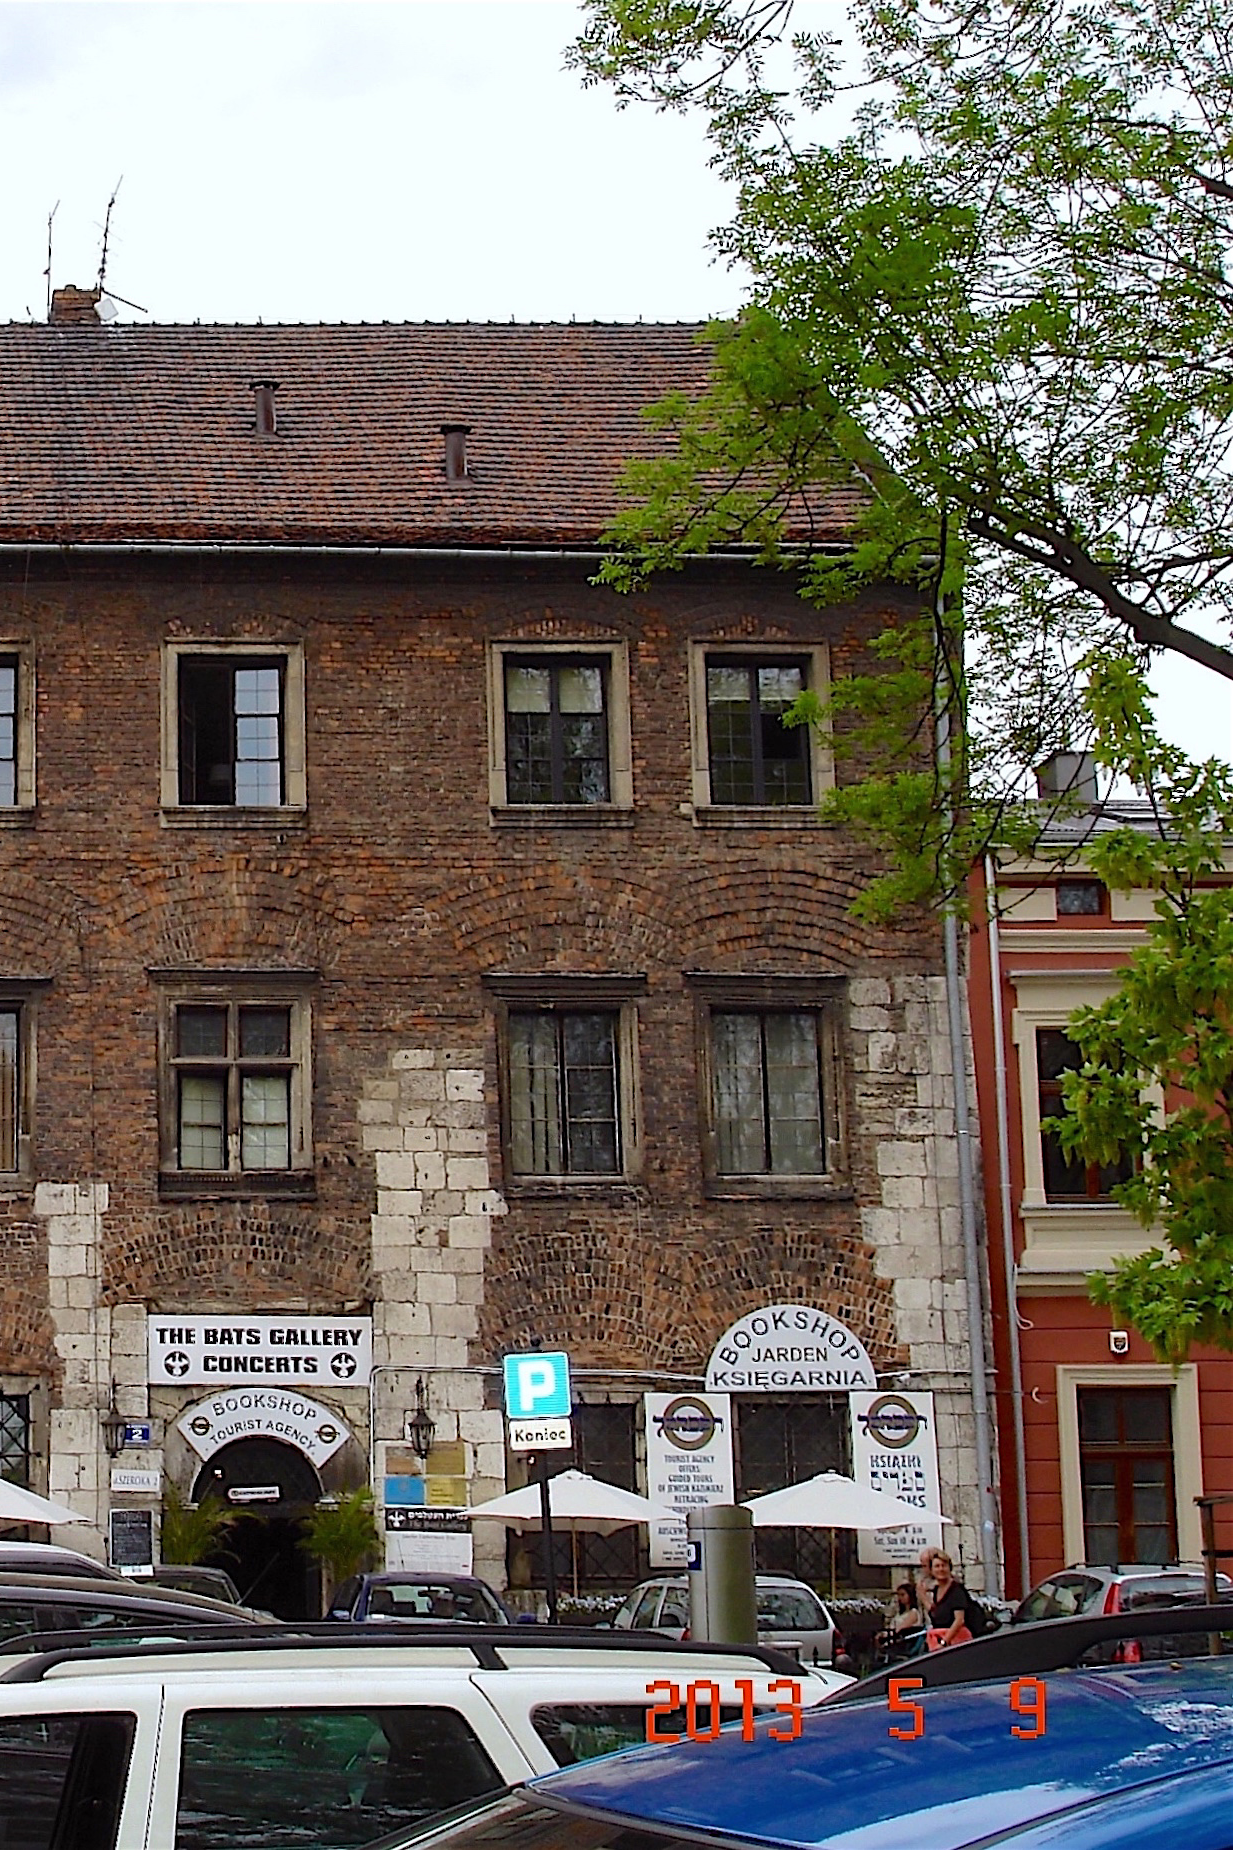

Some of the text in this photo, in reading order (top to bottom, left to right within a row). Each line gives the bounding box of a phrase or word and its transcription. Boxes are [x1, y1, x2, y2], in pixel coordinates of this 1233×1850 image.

[156, 1328, 363, 1346] THE BATS GALLERY
[719, 1310, 860, 1366] BOOKSHOP
[752, 1347, 828, 1362] JARDEN
[203, 1355, 318, 1374] CONCERTS
[518, 1360, 556, 1412] P
[713, 1370, 866, 1389] KSIĘGARNIA
[212, 1394, 317, 1420] BOOKSHOP
[132, 1429, 142, 1440] 2
[210, 1419, 317, 1450] TOURIST AGENCY
[515, 1428, 566, 1442] Koniec
